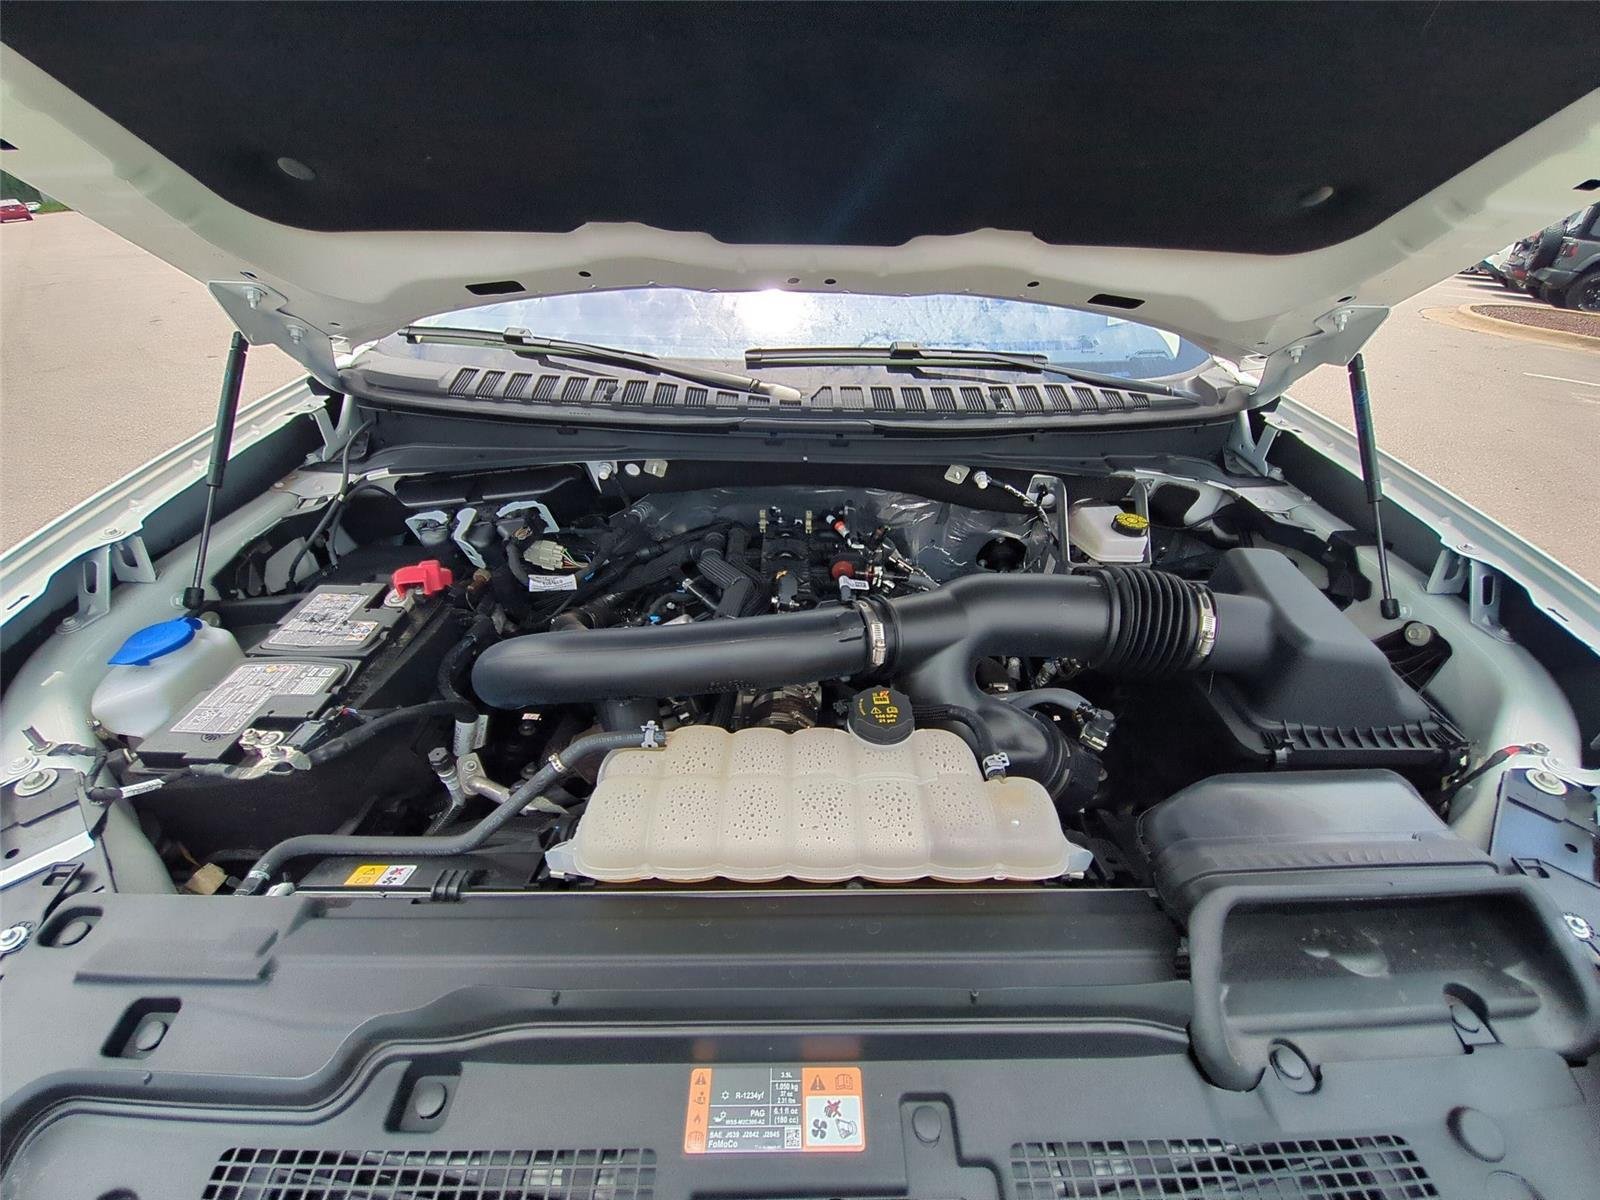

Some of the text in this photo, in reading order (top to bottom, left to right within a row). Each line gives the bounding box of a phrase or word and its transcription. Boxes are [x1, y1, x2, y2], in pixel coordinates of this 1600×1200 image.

[791, 1083, 799, 1092] kg
[735, 1091, 765, 1100] R-1234yf
[750, 1109, 766, 1117] PAG
[789, 1116, 799, 1125] cc)
[708, 1139, 738, 1149] FoMoCo
